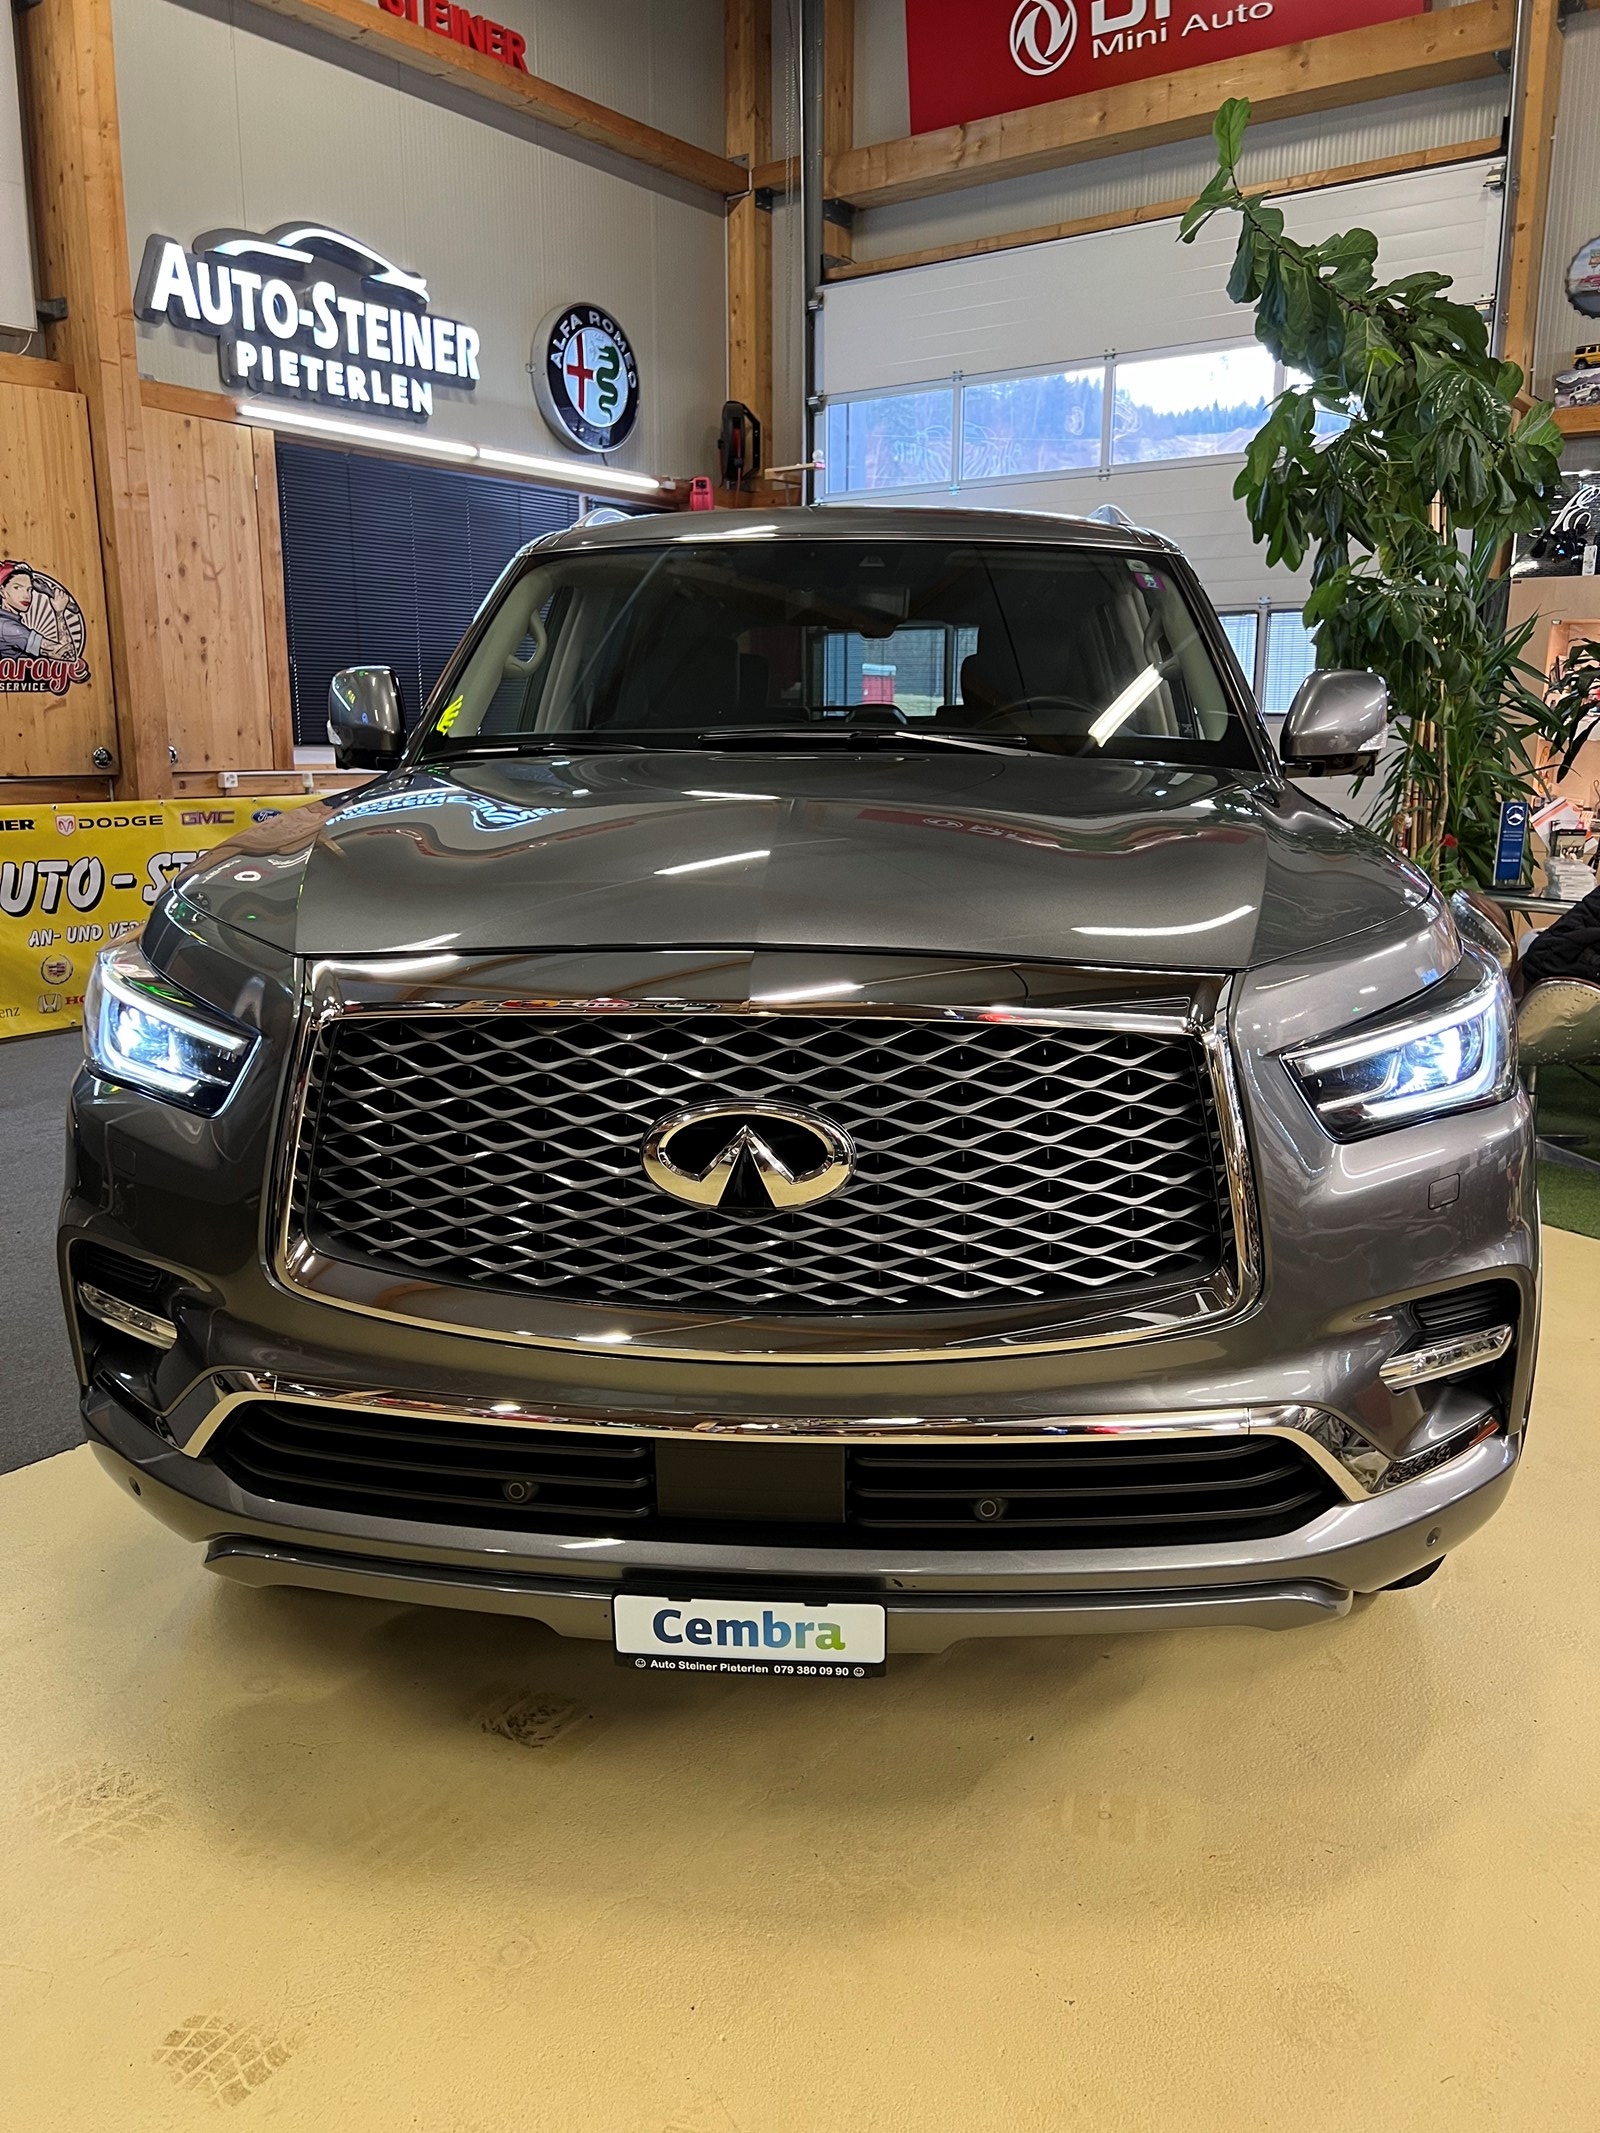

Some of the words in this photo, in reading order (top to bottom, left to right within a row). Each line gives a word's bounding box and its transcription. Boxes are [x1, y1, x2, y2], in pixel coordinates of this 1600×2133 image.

[1092, 22, 1167, 59] Mini
[1181, 2, 1274, 37] Auto
[151, 242, 481, 380] AUTO-STEINER
[551, 313, 583, 369] ALFA
[588, 310, 637, 389] ROMEO
[236, 340, 433, 416] PIETERLEN
[0, 682, 46, 691] SERVICE
[78, 814, 164, 829] DODGE
[181, 811, 235, 826] GMC
[29, 928, 62, 947] AN-
[66, 923, 103, 942] UND
[652, 1608, 846, 1651] Cembra
[650, 1659, 676, 1669] Auto
[678, 1660, 717, 1671] Steiner
[719, 1663, 769, 1674] Pieterlen
[773, 1664, 794, 1675] 079
[796, 1665, 817, 1676] 380
[818, 1666, 834, 1676] 09
[835, 1667, 849, 1677] 90
